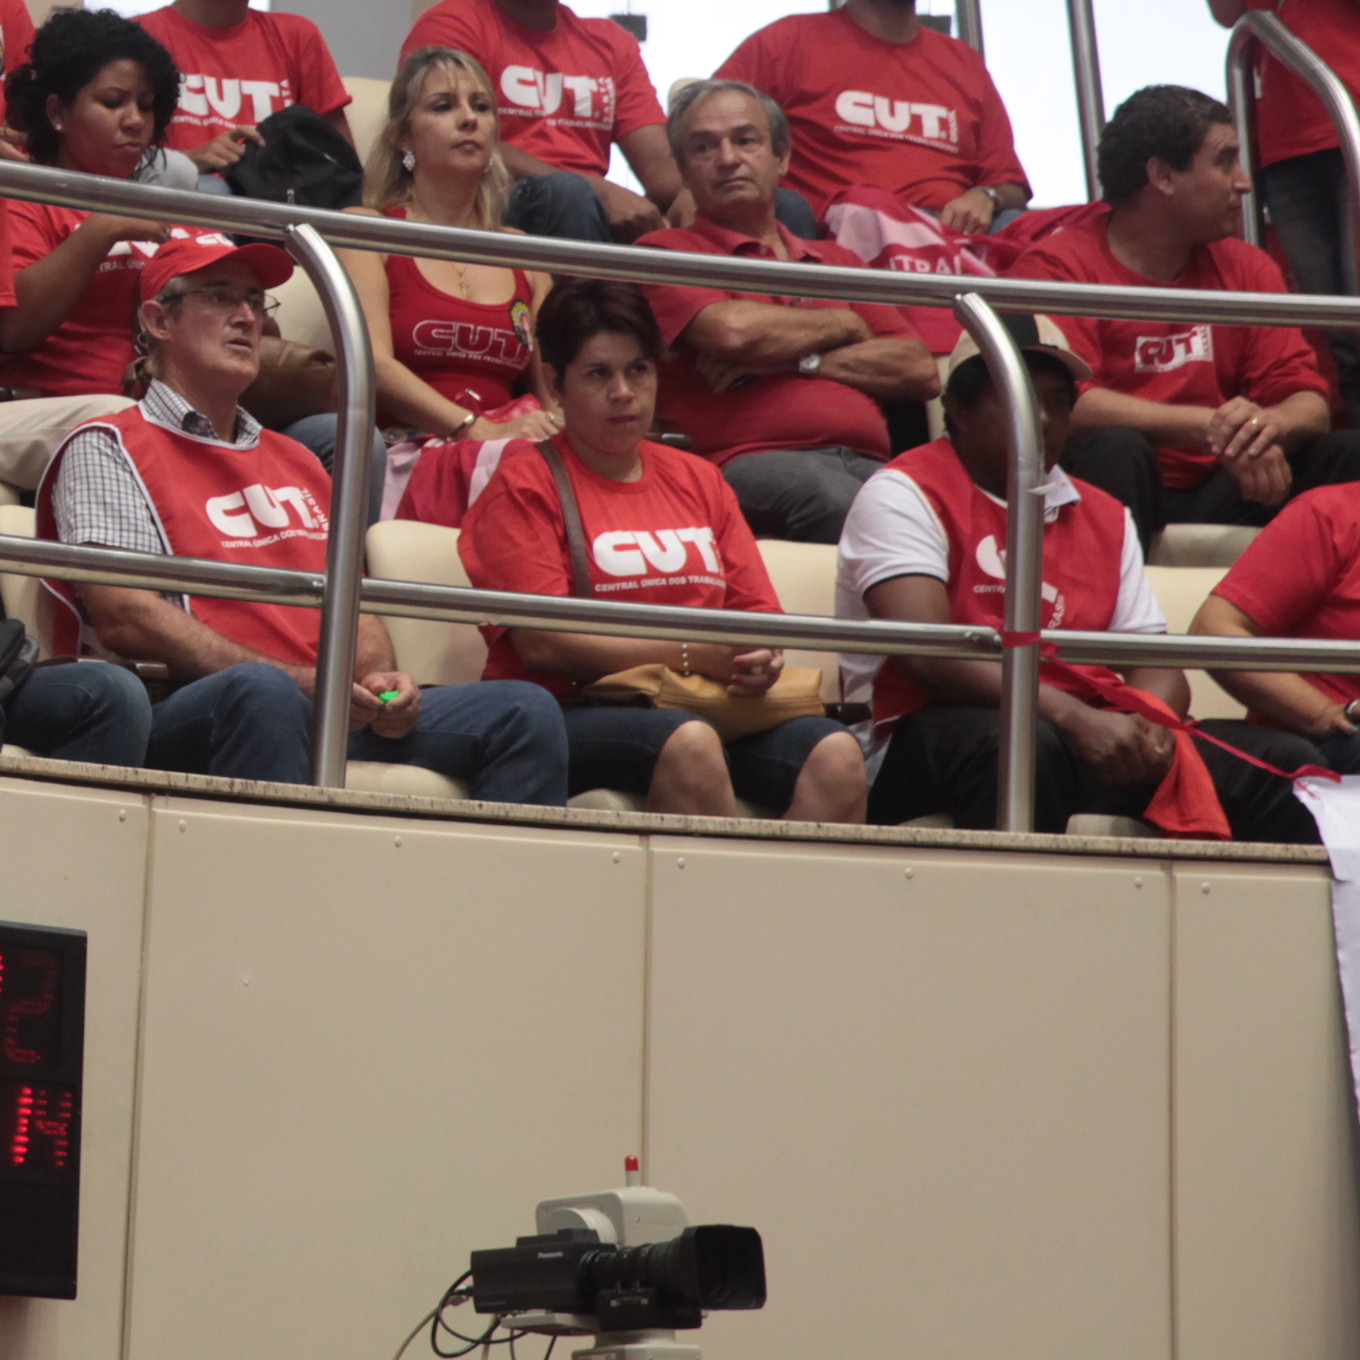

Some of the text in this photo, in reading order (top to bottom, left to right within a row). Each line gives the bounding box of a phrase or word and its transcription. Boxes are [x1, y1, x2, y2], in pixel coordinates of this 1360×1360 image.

[177, 74, 280, 123] CUT
[501, 64, 599, 118] CUT
[835, 90, 948, 139] CUT
[413, 319, 523, 362] CUT
[206, 484, 313, 538] CUT
[593, 526, 720, 577] CUT
[594, 580, 639, 593] CENTRAL
